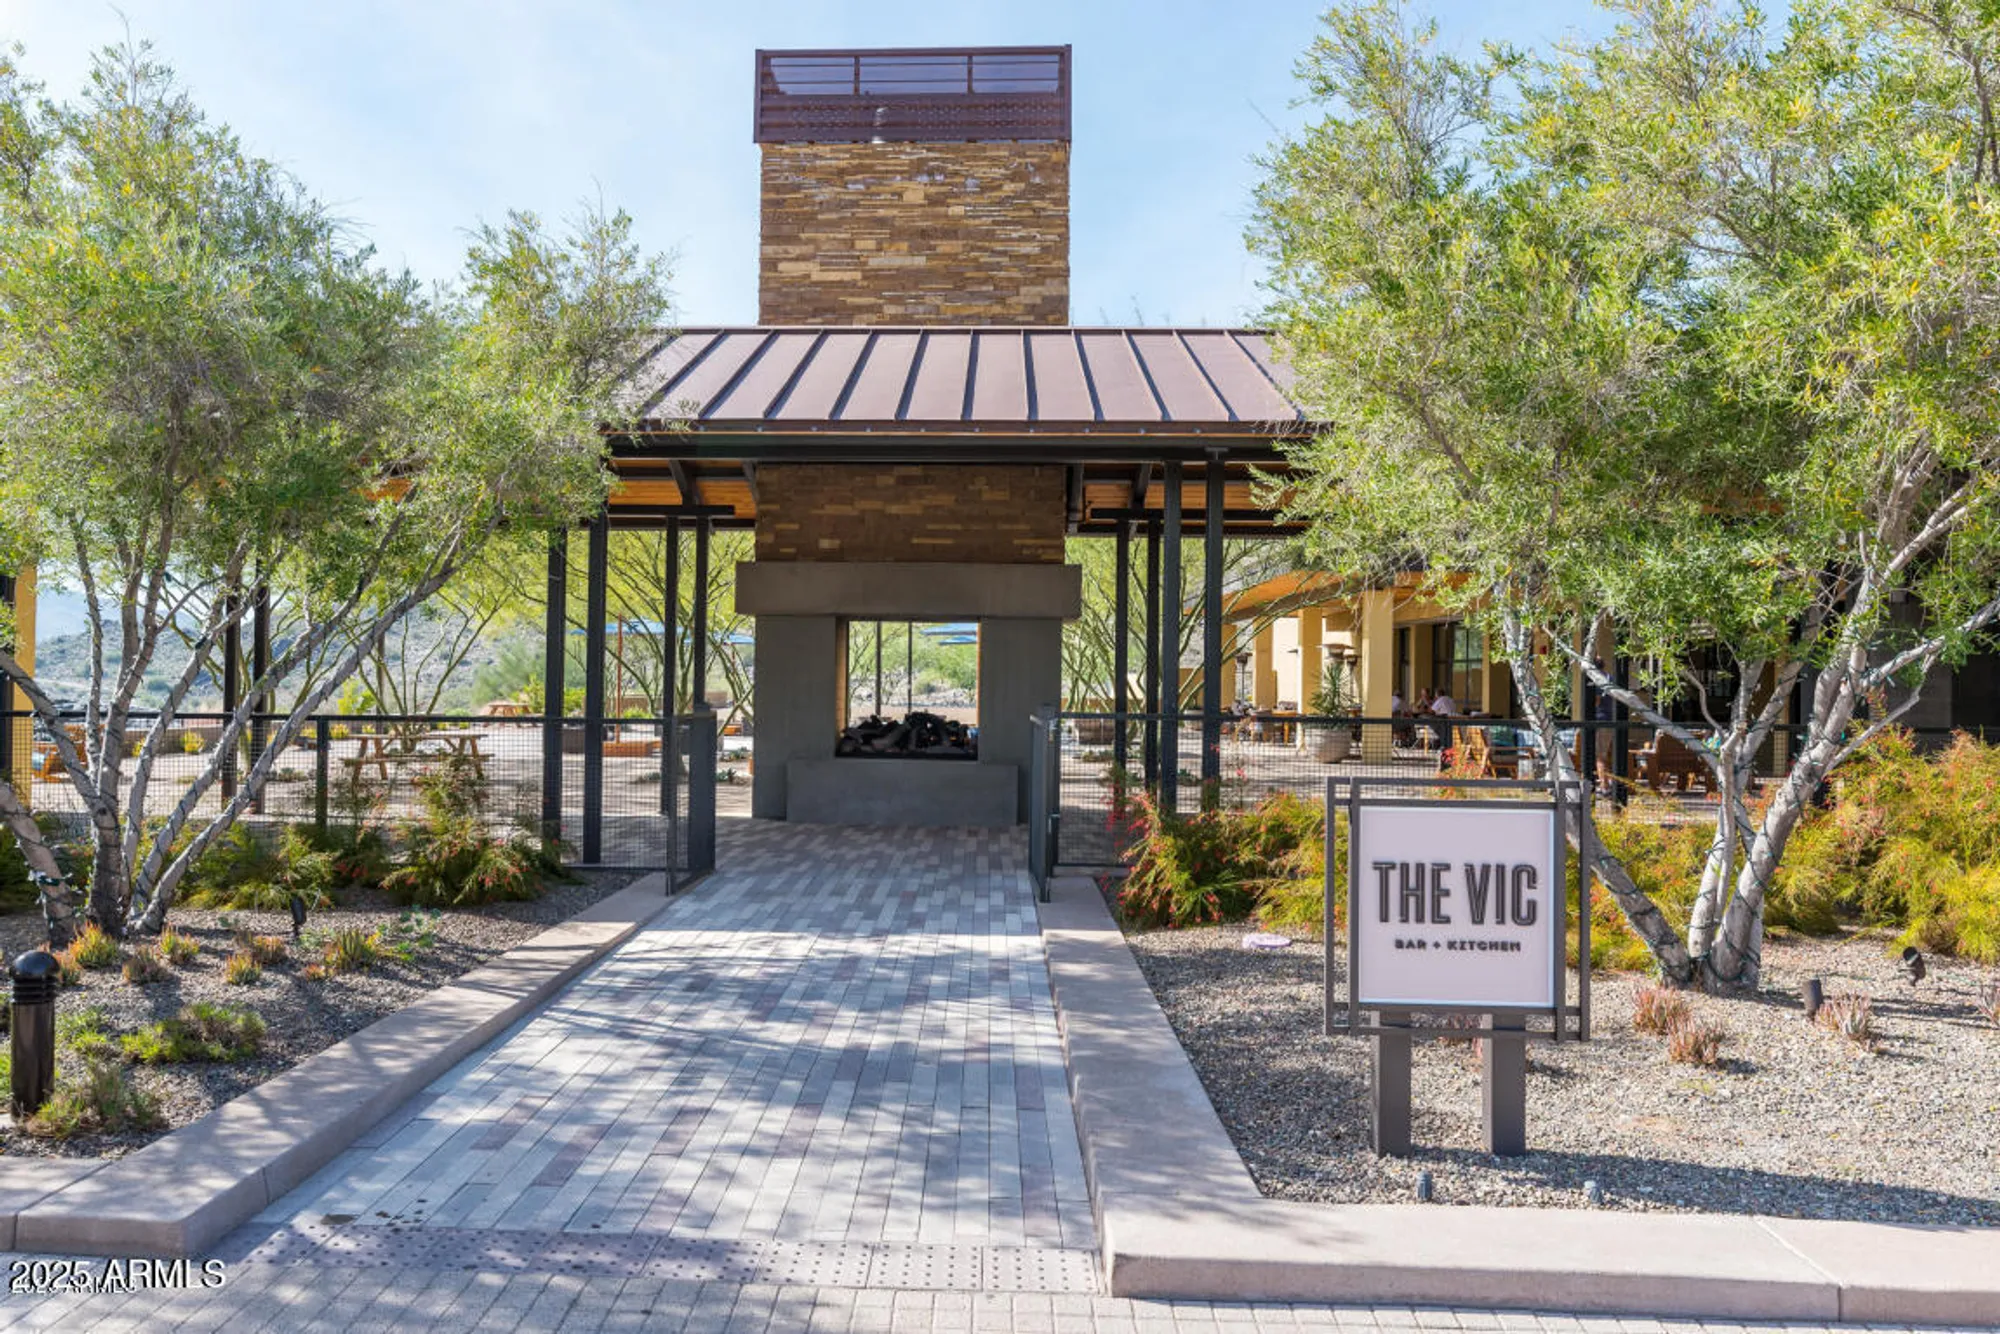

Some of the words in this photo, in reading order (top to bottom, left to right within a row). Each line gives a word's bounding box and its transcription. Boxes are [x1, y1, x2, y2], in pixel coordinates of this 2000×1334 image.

[1372, 862, 1451, 925] THE
[1464, 863, 1537, 926] VIC
[1395, 939, 1427, 950] BAR
[1447, 940, 1521, 952] KITCHEN
